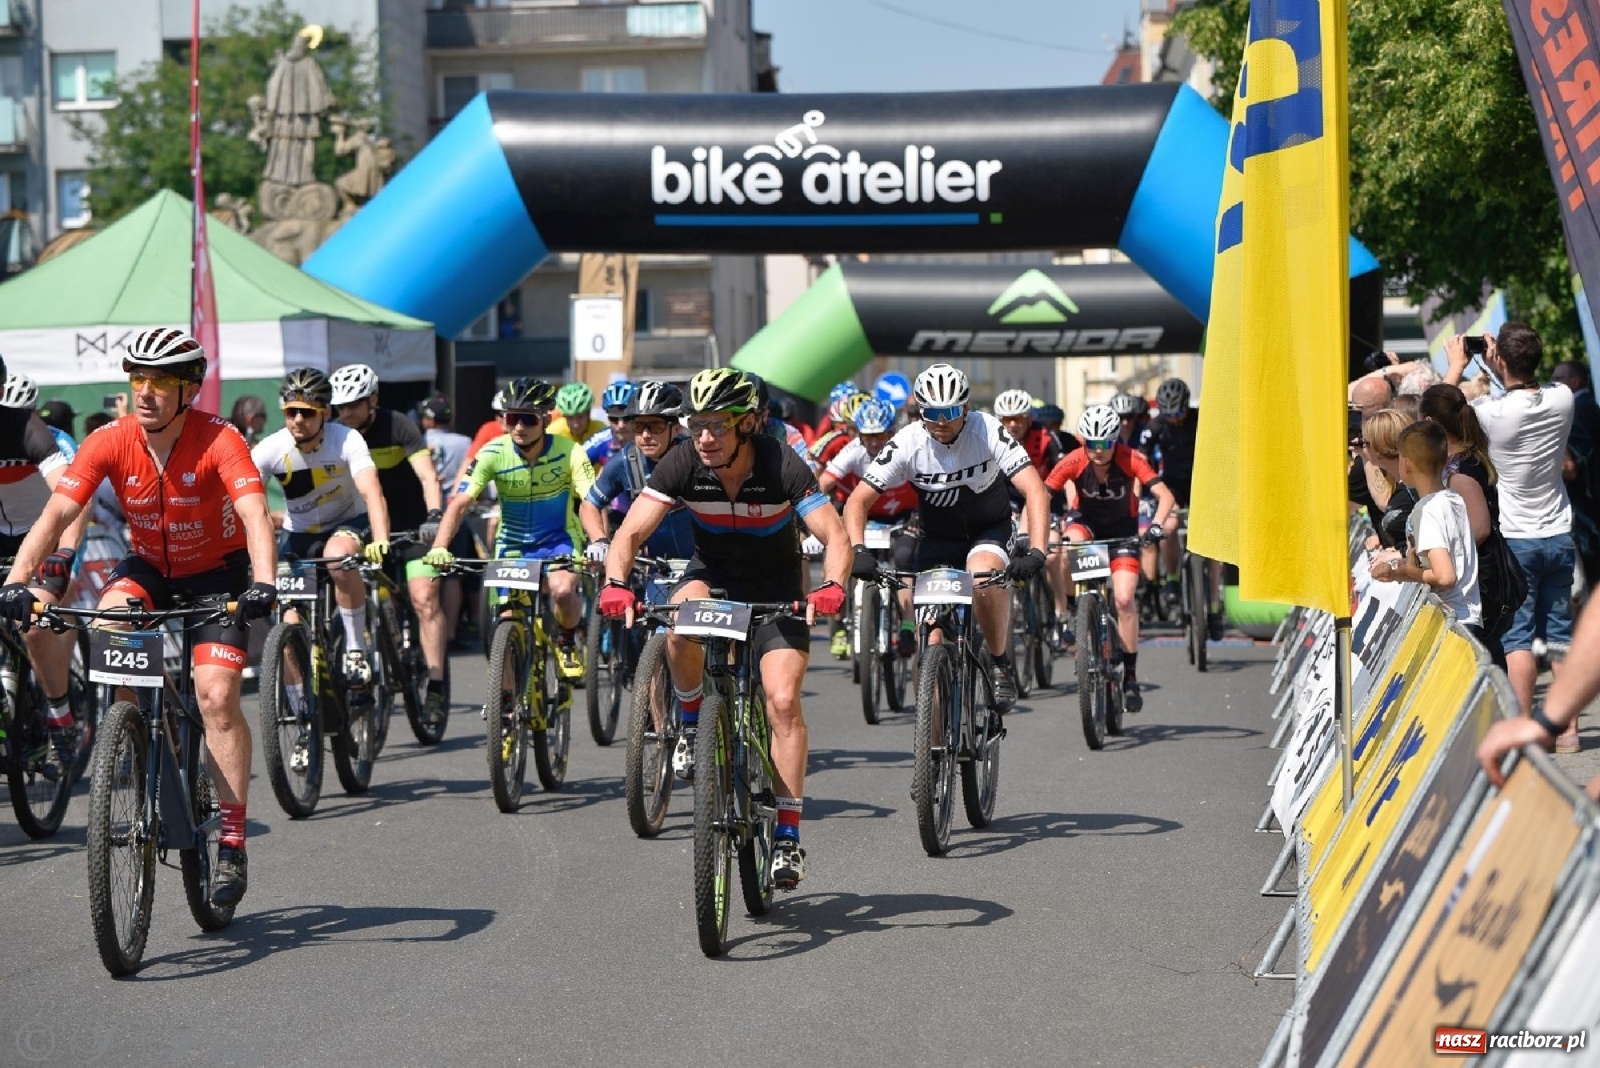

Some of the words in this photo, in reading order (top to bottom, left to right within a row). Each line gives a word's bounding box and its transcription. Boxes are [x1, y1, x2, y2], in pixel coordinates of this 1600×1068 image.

[651, 144, 784, 205] bike
[801, 144, 1003, 205] atelier
[592, 333, 605, 353] 0
[908, 326, 1165, 353] MERIDA
[914, 458, 993, 485] SCOTT
[169, 520, 204, 533] BIKE
[1076, 555, 1101, 570] 1401
[926, 580, 963, 594] 1796
[693, 610, 733, 626] 1871
[103, 649, 150, 670] 1245
[210, 645, 244, 665] Nice
